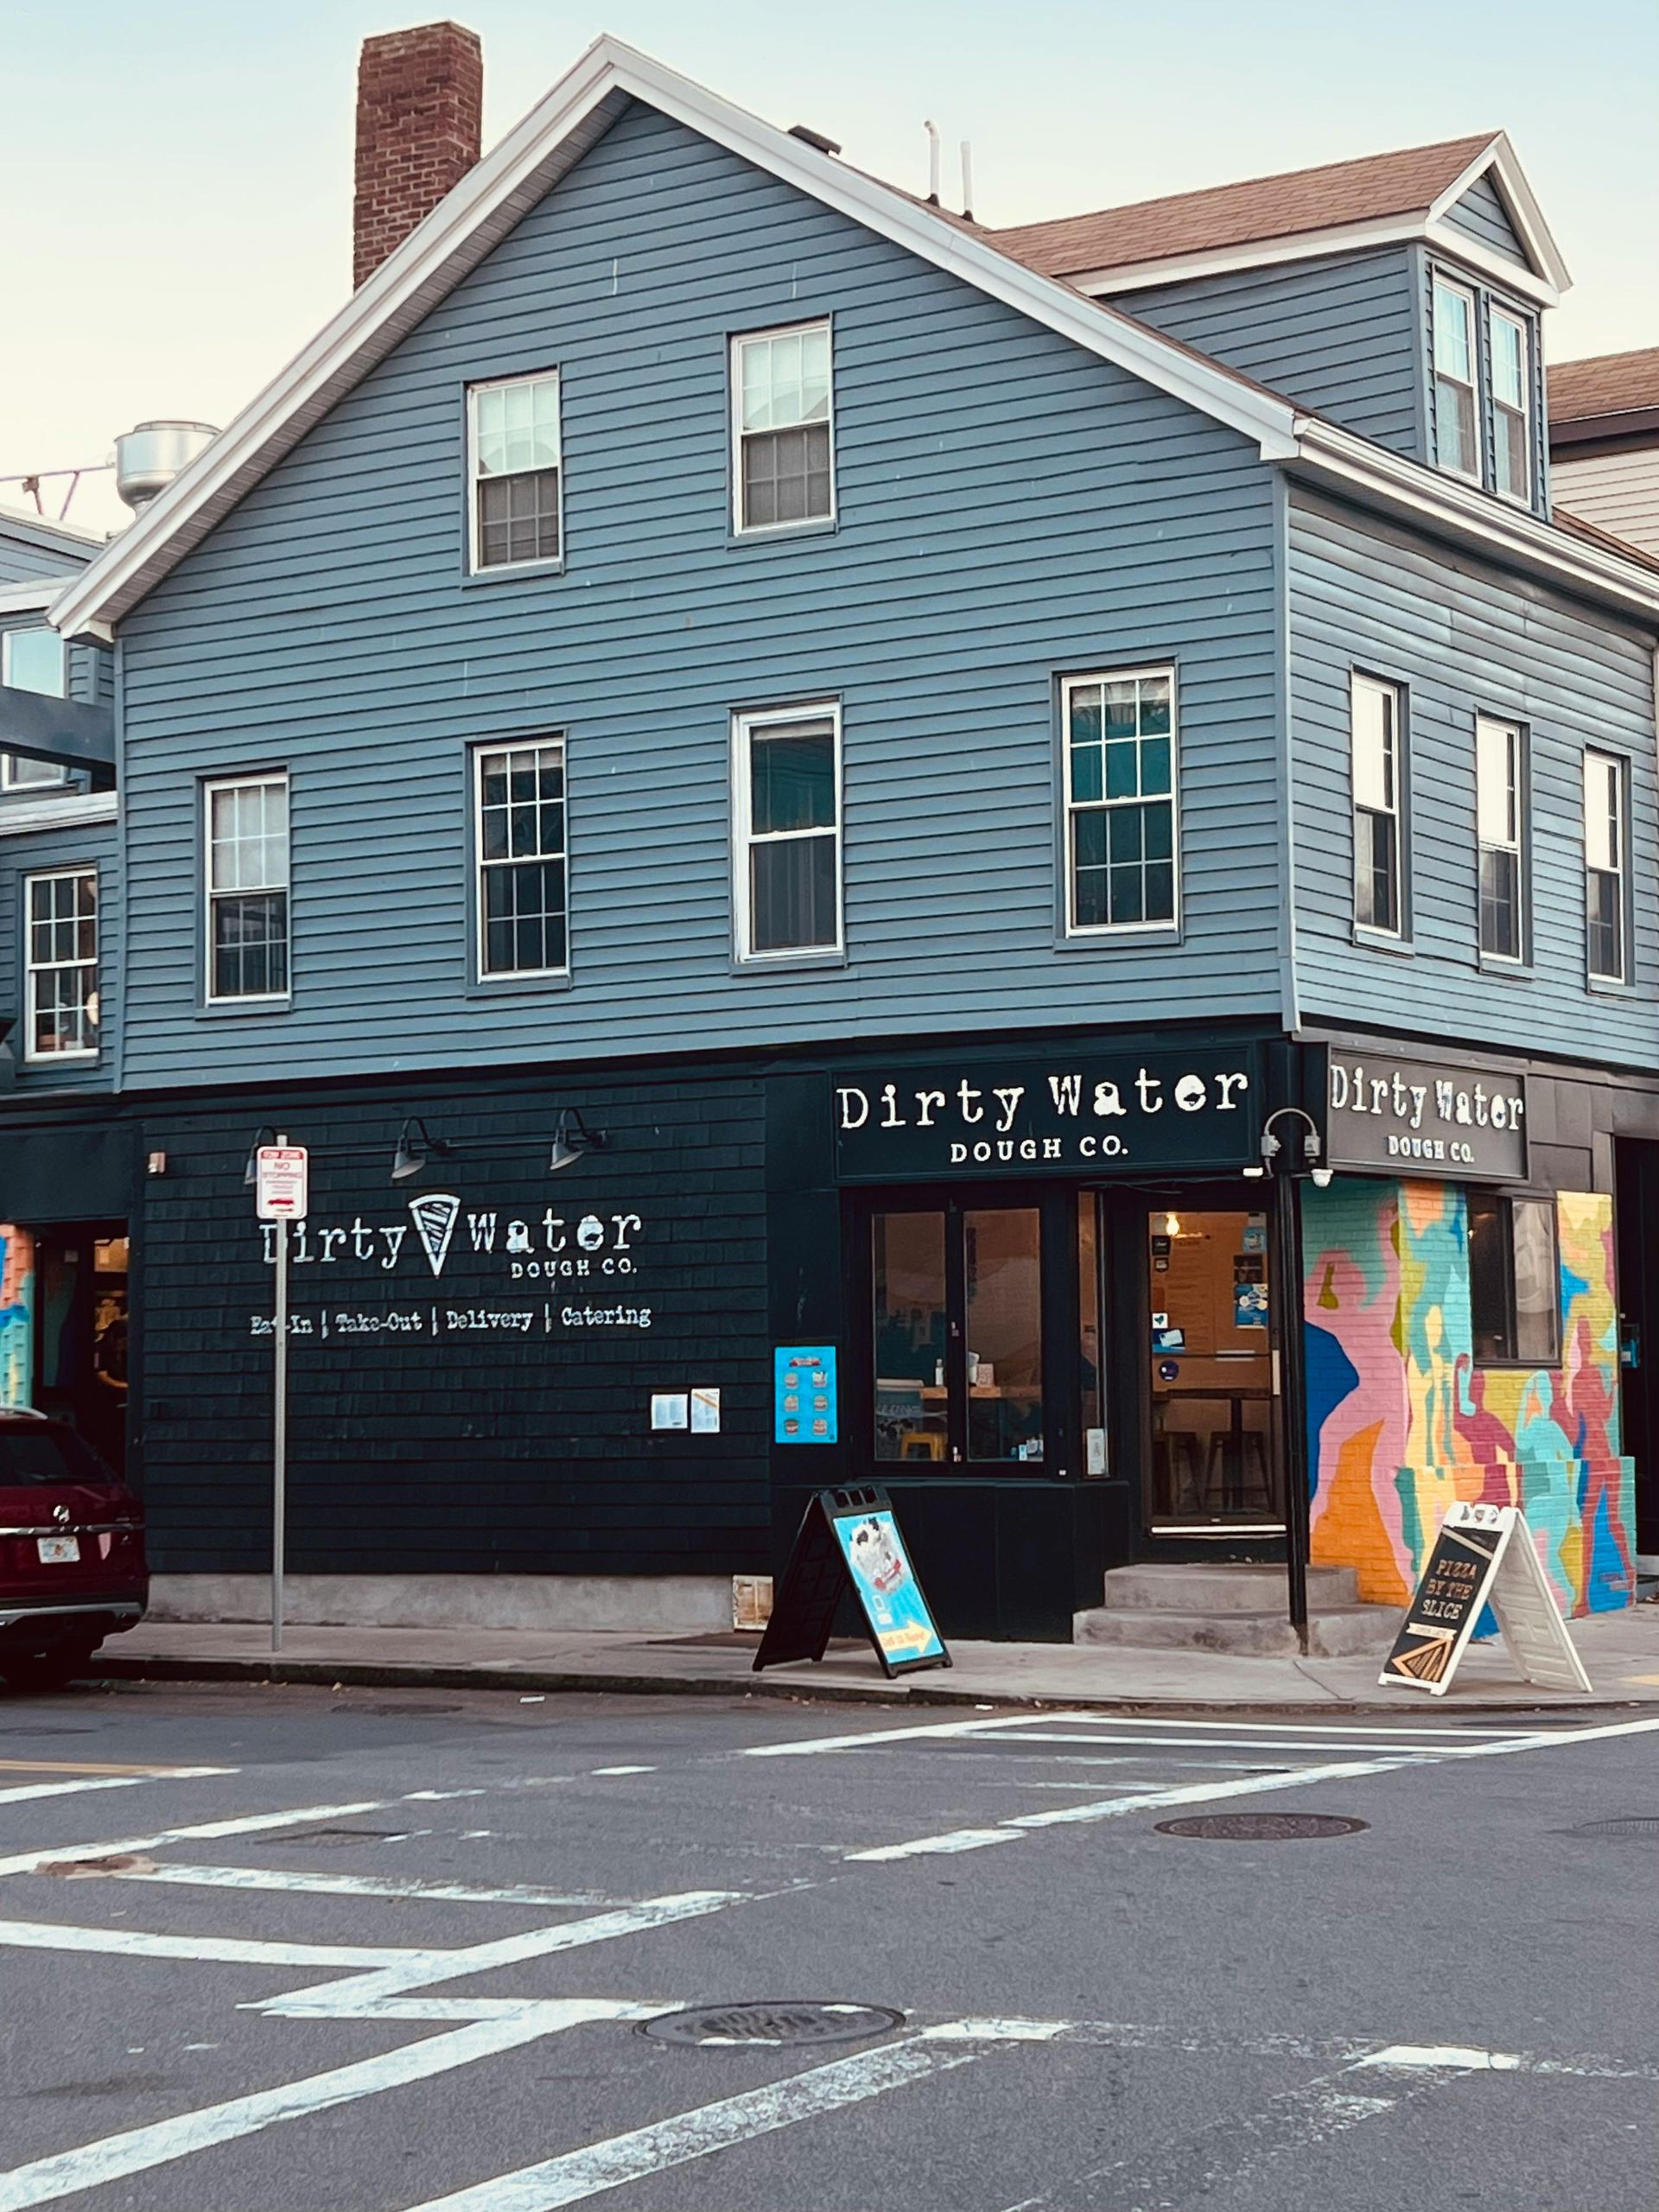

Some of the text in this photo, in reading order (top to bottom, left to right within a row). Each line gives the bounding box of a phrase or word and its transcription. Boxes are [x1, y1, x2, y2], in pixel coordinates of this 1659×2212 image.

[836, 1068, 1249, 1132] Dirty Water
[1330, 1065, 1523, 1130] Dirty Water
[950, 1135, 1128, 1163] DOUGH CO.
[1388, 1135, 1475, 1163] DOUGH CO.
[258, 1207, 642, 1269] Dirty Water
[511, 1257, 638, 1279] DOUGH CO.
[334, 1311, 423, 1332] Take-Out
[446, 1309, 534, 1332] Delivery
[562, 1305, 652, 1328] Catering
[1434, 1559, 1478, 1580] PIZZA
[1424, 1578, 1473, 1600] BY THE
[1421, 1599, 1463, 1620] SLICE
